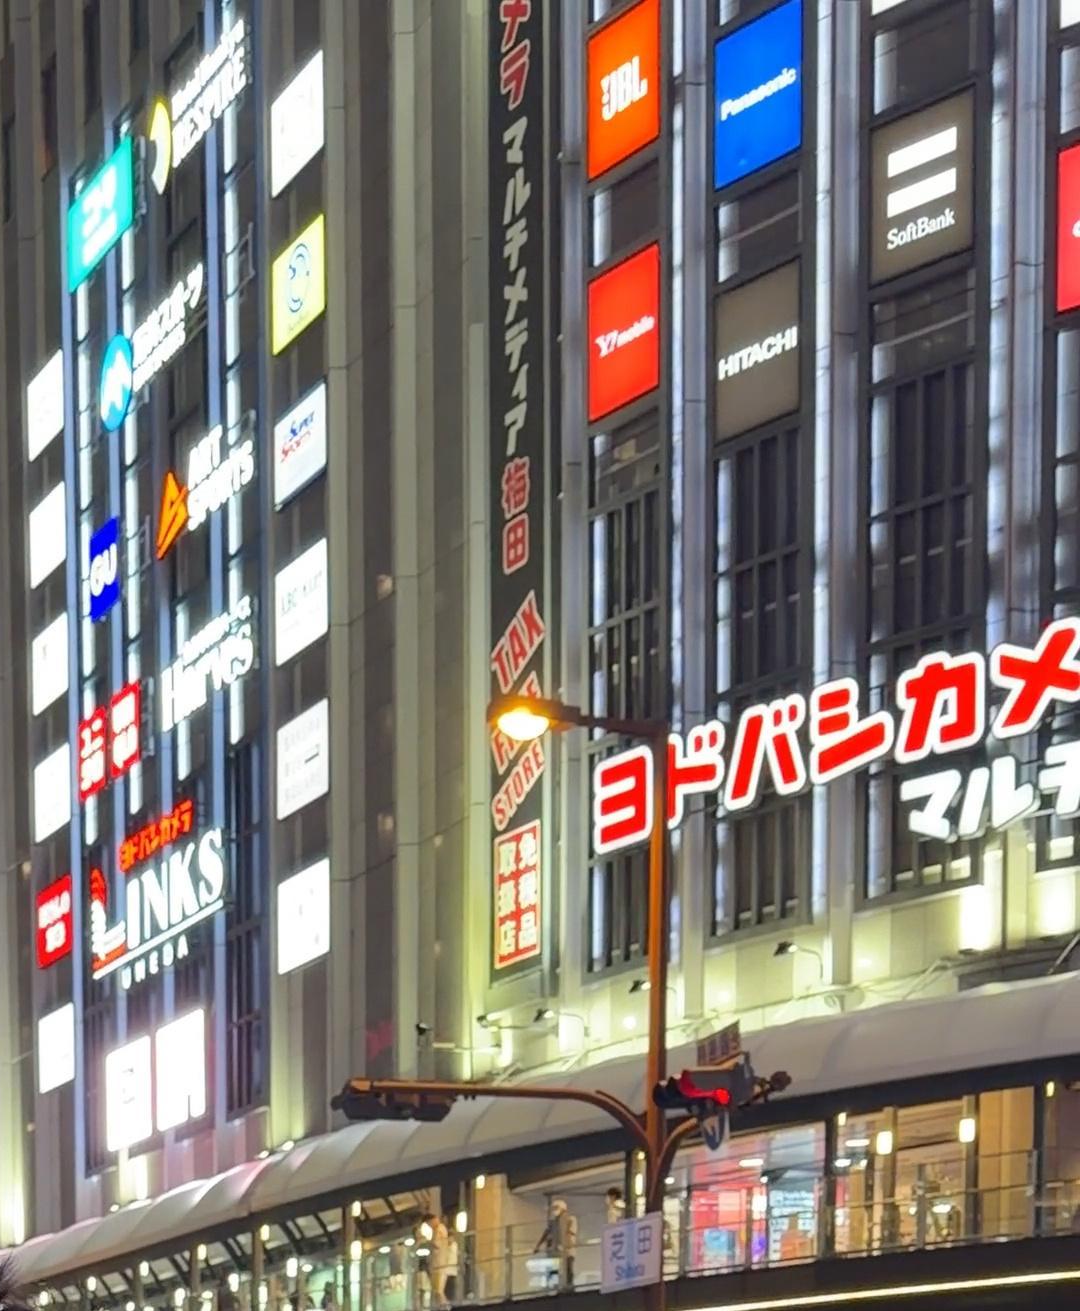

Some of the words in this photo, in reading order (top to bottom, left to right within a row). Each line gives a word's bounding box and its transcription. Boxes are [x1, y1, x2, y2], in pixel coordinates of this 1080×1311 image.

[601, 56, 648, 121] JBL
[721, 67, 796, 121] Panasonic
[887, 208, 955, 250] SoftBank
[719, 326, 798, 381] HITACHI
[187, 439, 254, 532] SPORTS
[90, 542, 117, 598] GU
[490, 590, 546, 694] TAX
[594, 616, 1080, 856] ヨドバシカメ
[491, 737, 545, 831] STORE
[91, 827, 225, 961] LINKS
[121, 933, 189, 990] UMEDA
